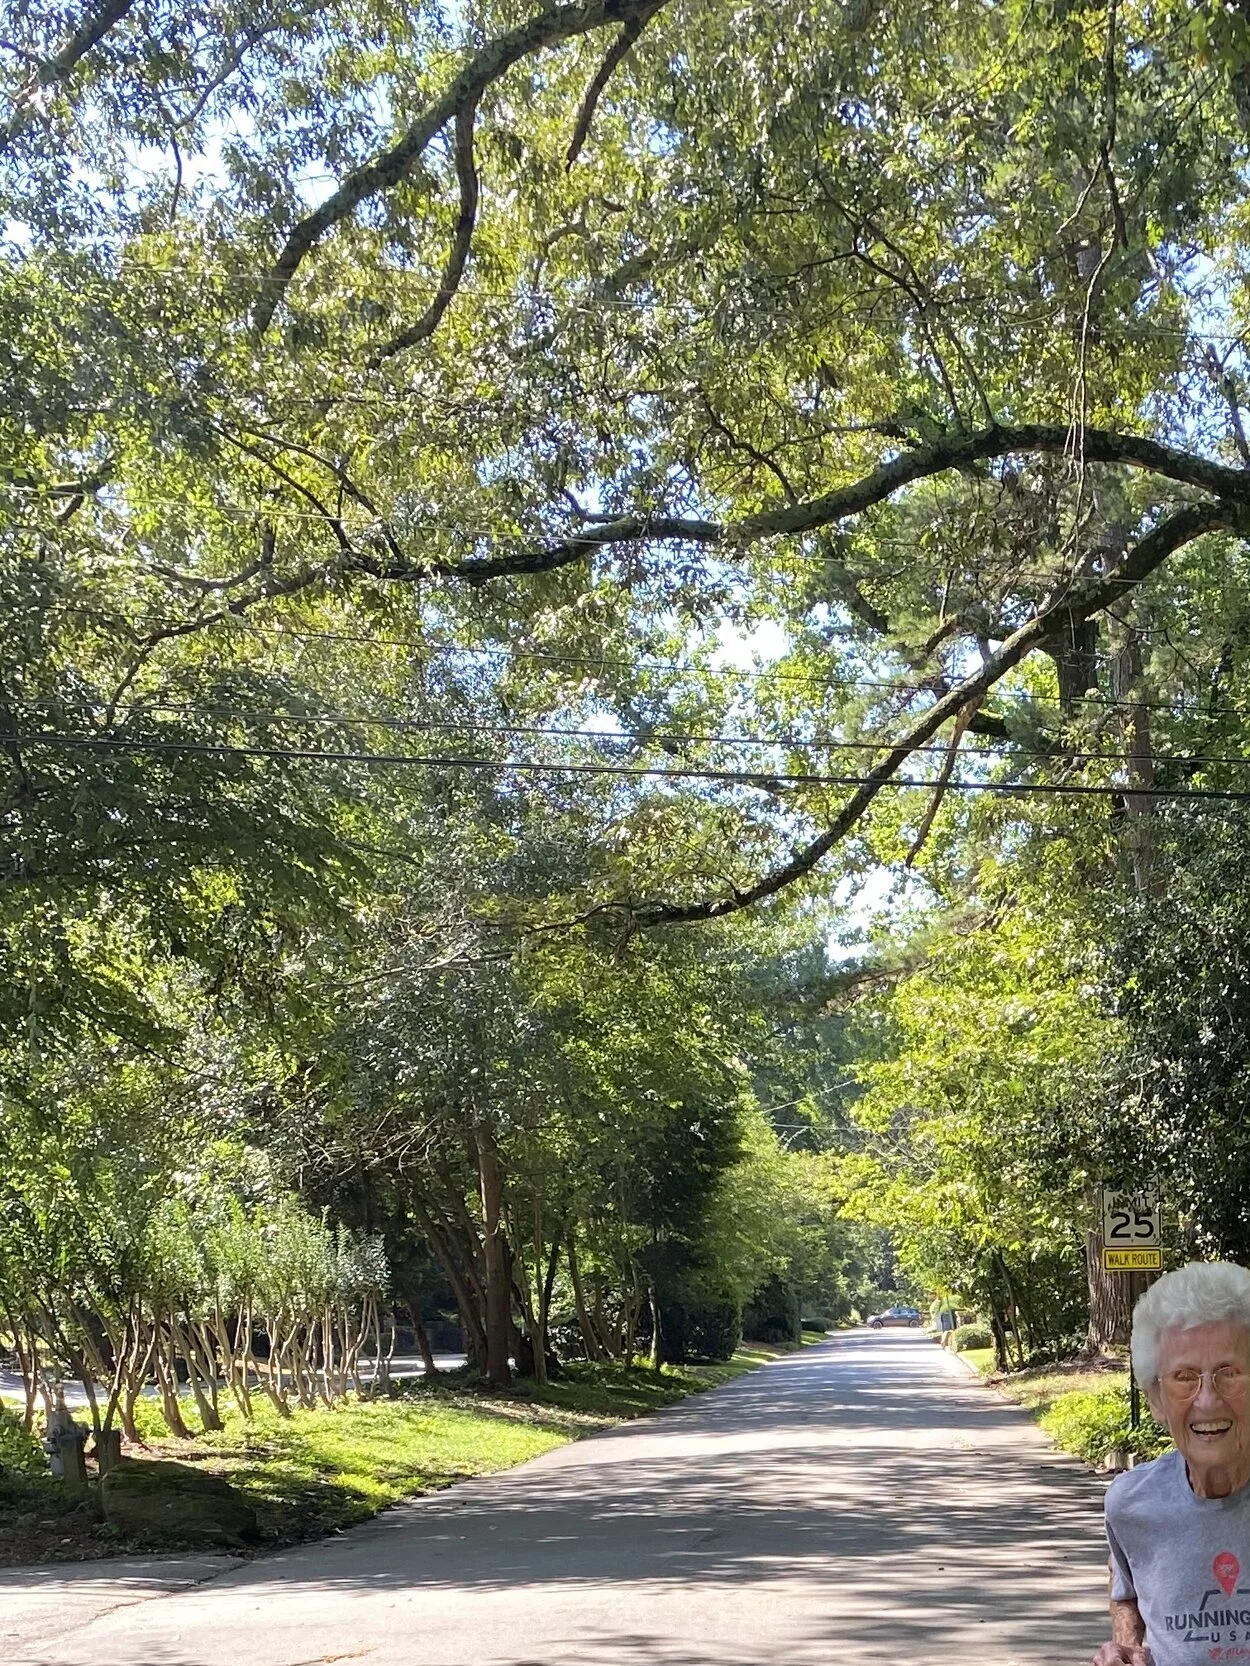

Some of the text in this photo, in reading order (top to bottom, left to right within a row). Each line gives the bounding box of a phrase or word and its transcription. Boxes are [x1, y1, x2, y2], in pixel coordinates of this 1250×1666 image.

[1110, 1212, 1154, 1238] 25
[1107, 1253, 1158, 1265] WALK ROUTE
